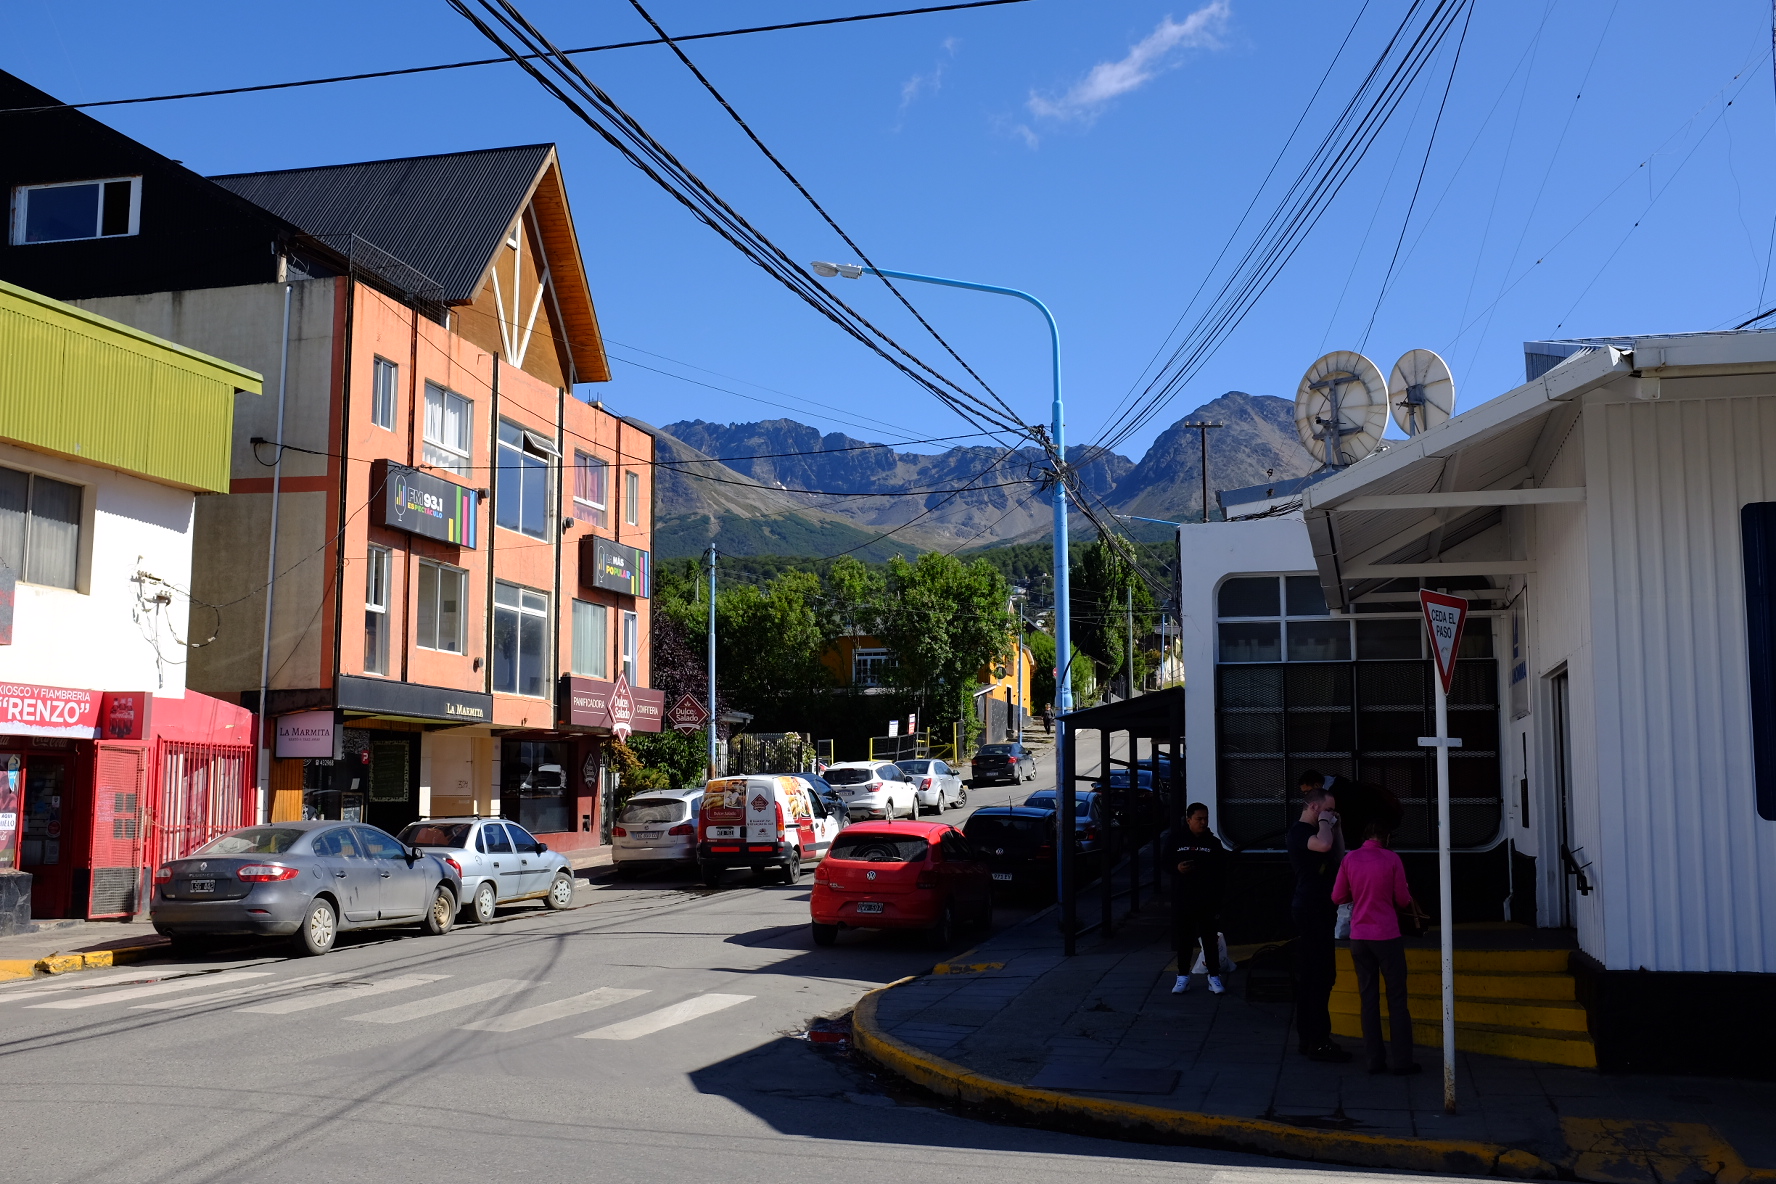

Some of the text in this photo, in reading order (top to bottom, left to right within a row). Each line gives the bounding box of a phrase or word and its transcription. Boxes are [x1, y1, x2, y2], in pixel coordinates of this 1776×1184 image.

[408, 487, 443, 512] FM 93.1
[606, 565, 631, 580] POPULAR
[1431, 609, 1456, 625] CEDA EL
[1436, 625, 1452, 638] PASO
[33, 687, 40, 698] Y
[41, 688, 91, 702] FIAMBRERIA
[573, 696, 605, 709] PANIFICADORA
[614, 696, 627, 707] Dulce
[615, 707, 631, 719] Salado
[675, 707, 694, 715] Dulce
[280, 727, 330, 736] LA MARMITA
